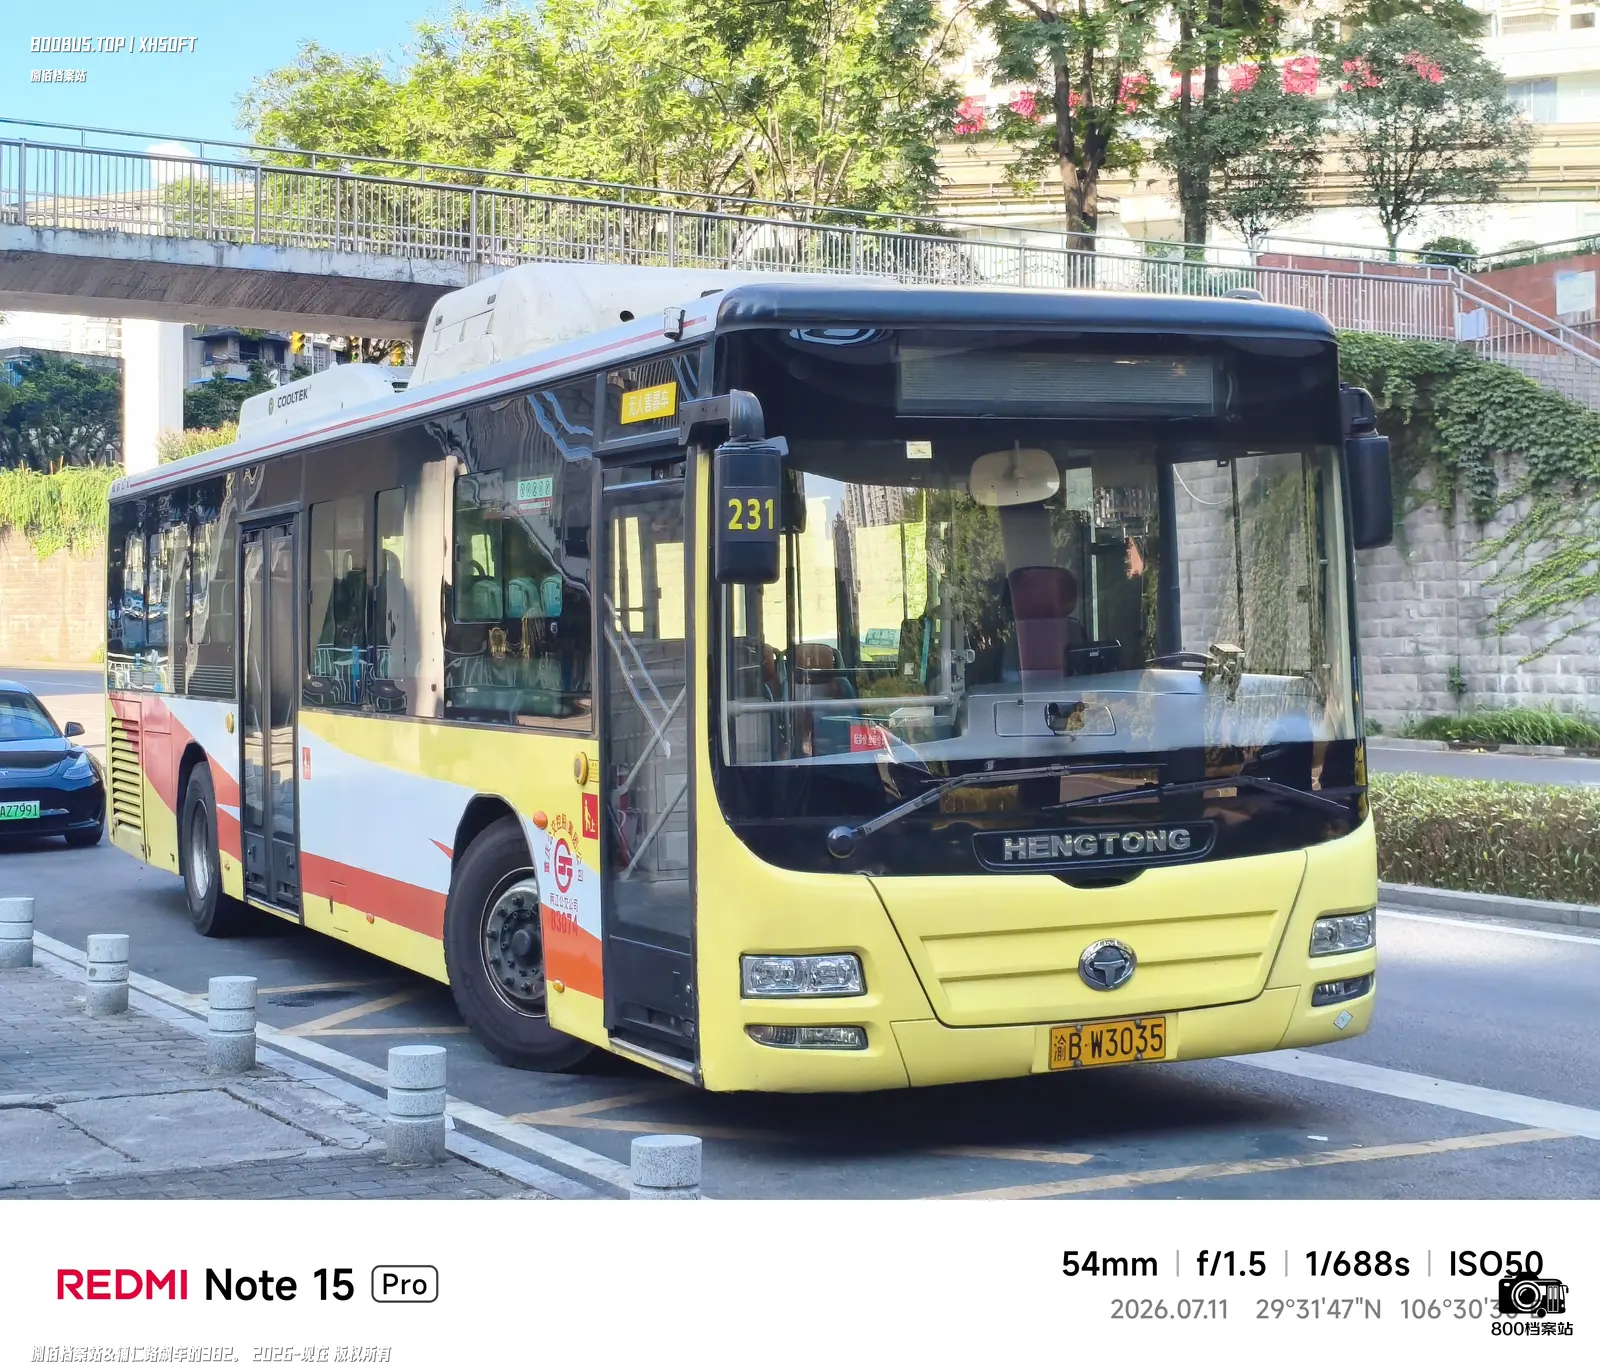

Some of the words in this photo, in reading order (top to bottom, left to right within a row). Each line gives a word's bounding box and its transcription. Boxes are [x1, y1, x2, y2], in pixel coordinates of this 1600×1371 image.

[277, 388, 308, 408] COOLTEK
[728, 498, 774, 530] 231
[1004, 829, 1191, 860] HENGTONG
